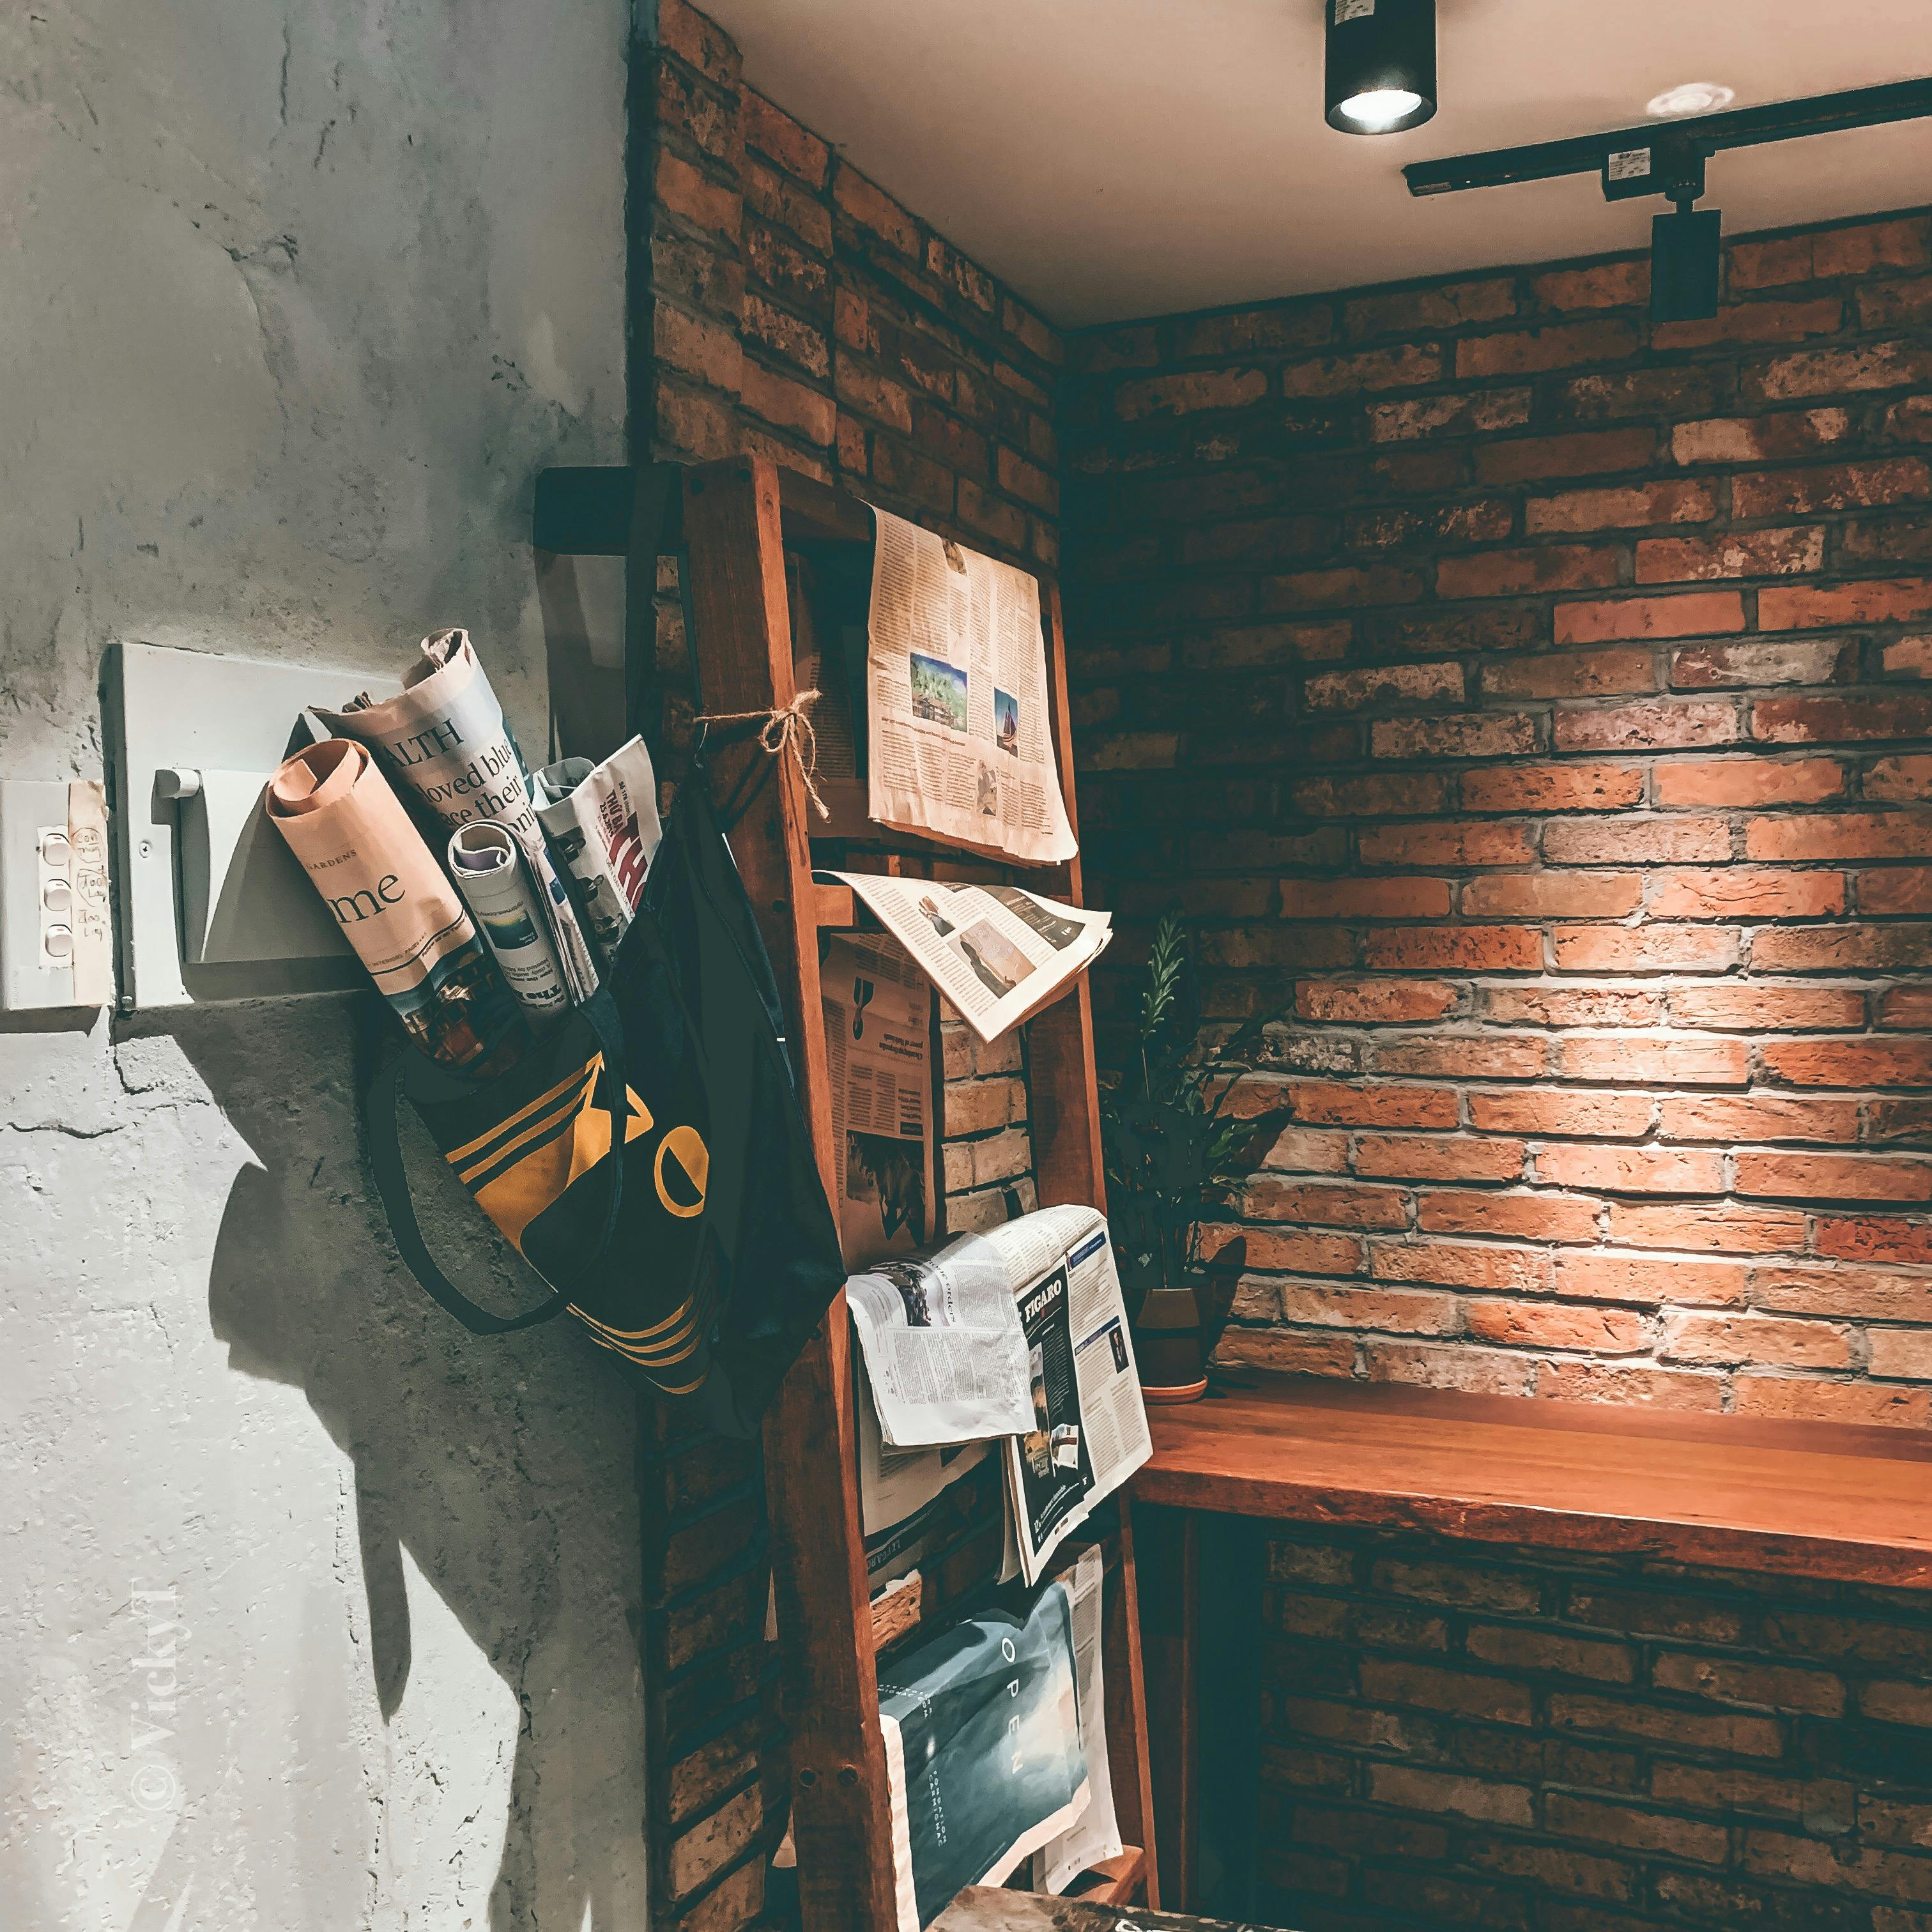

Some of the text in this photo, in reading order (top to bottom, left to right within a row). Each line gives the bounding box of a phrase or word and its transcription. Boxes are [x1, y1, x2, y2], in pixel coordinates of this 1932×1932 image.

[480, 773, 520, 818] their
[327, 873, 406, 924] me
[1024, 1279, 1063, 1323] FIGARO
